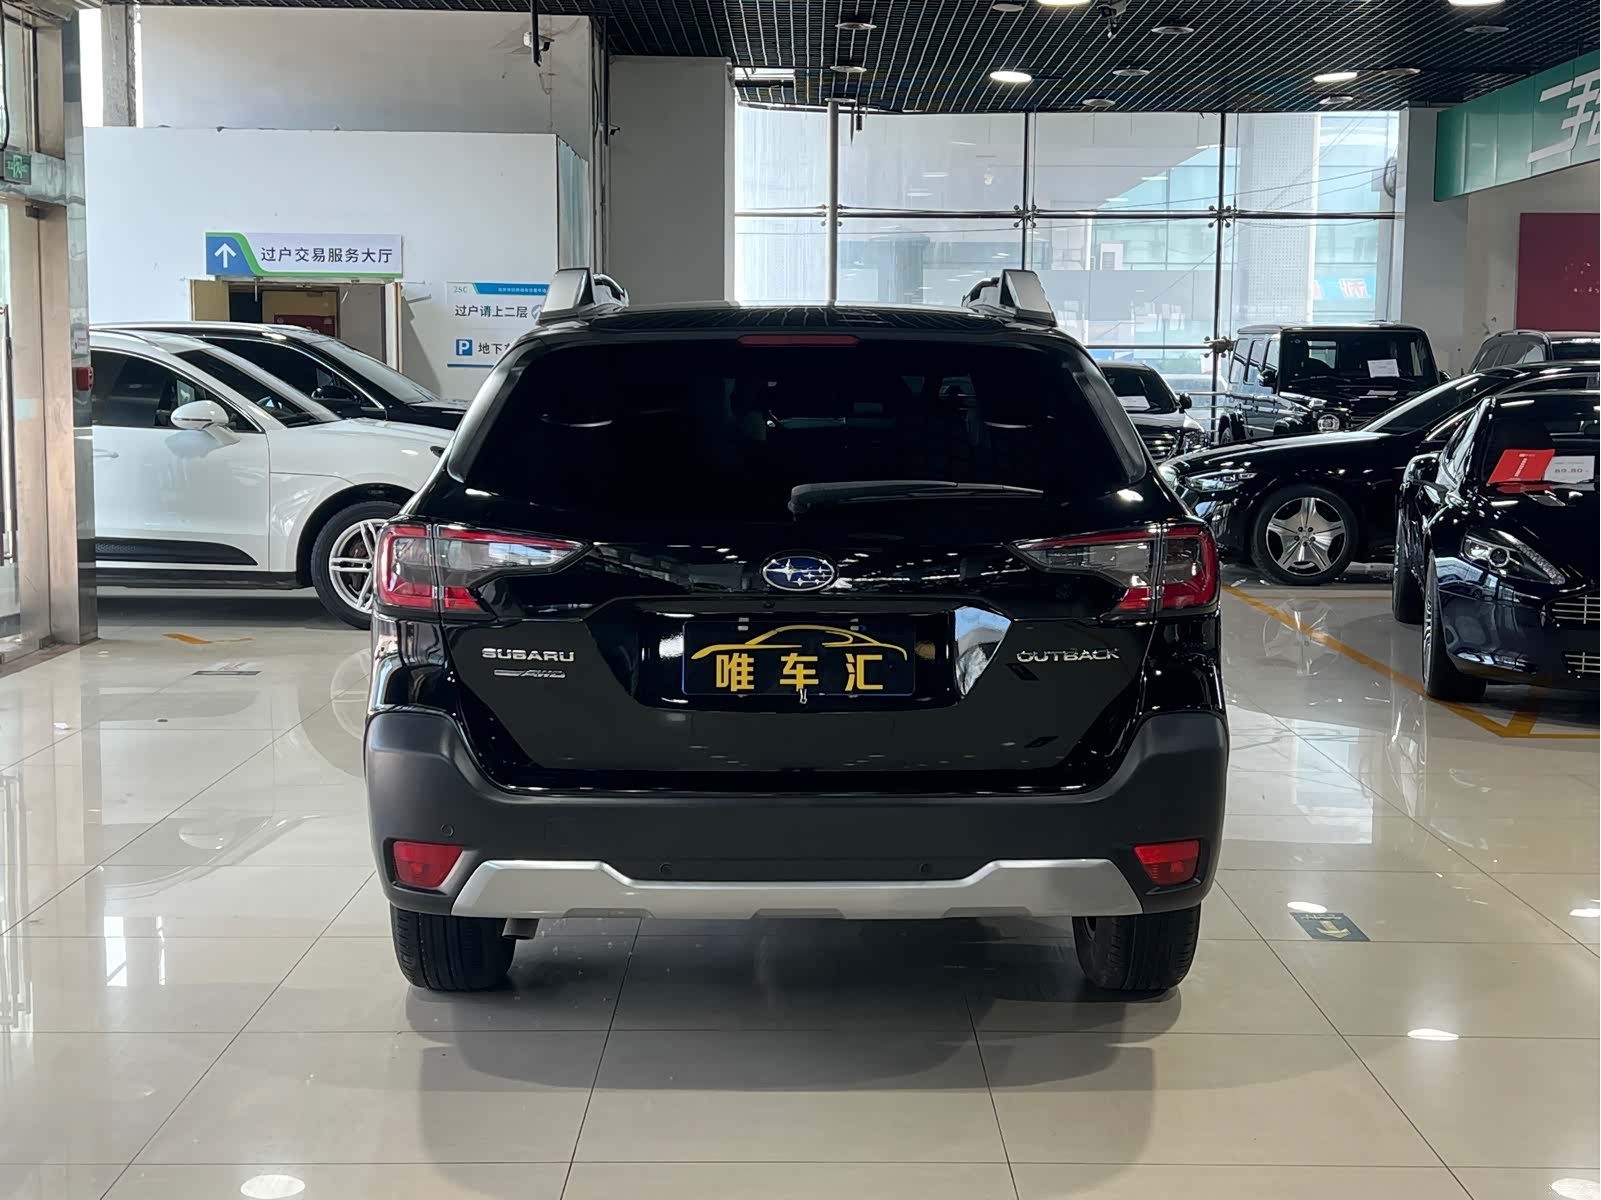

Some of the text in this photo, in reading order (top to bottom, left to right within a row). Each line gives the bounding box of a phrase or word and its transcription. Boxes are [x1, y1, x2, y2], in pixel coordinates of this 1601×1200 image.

[261, 247, 393, 263] 过户交易服务大厅
[455, 305, 528, 318] 过户请上二层
[482, 648, 575, 662] SUBARU
[1016, 648, 1120, 662] OUTBACK
[716, 652, 883, 692] 唯车汇
